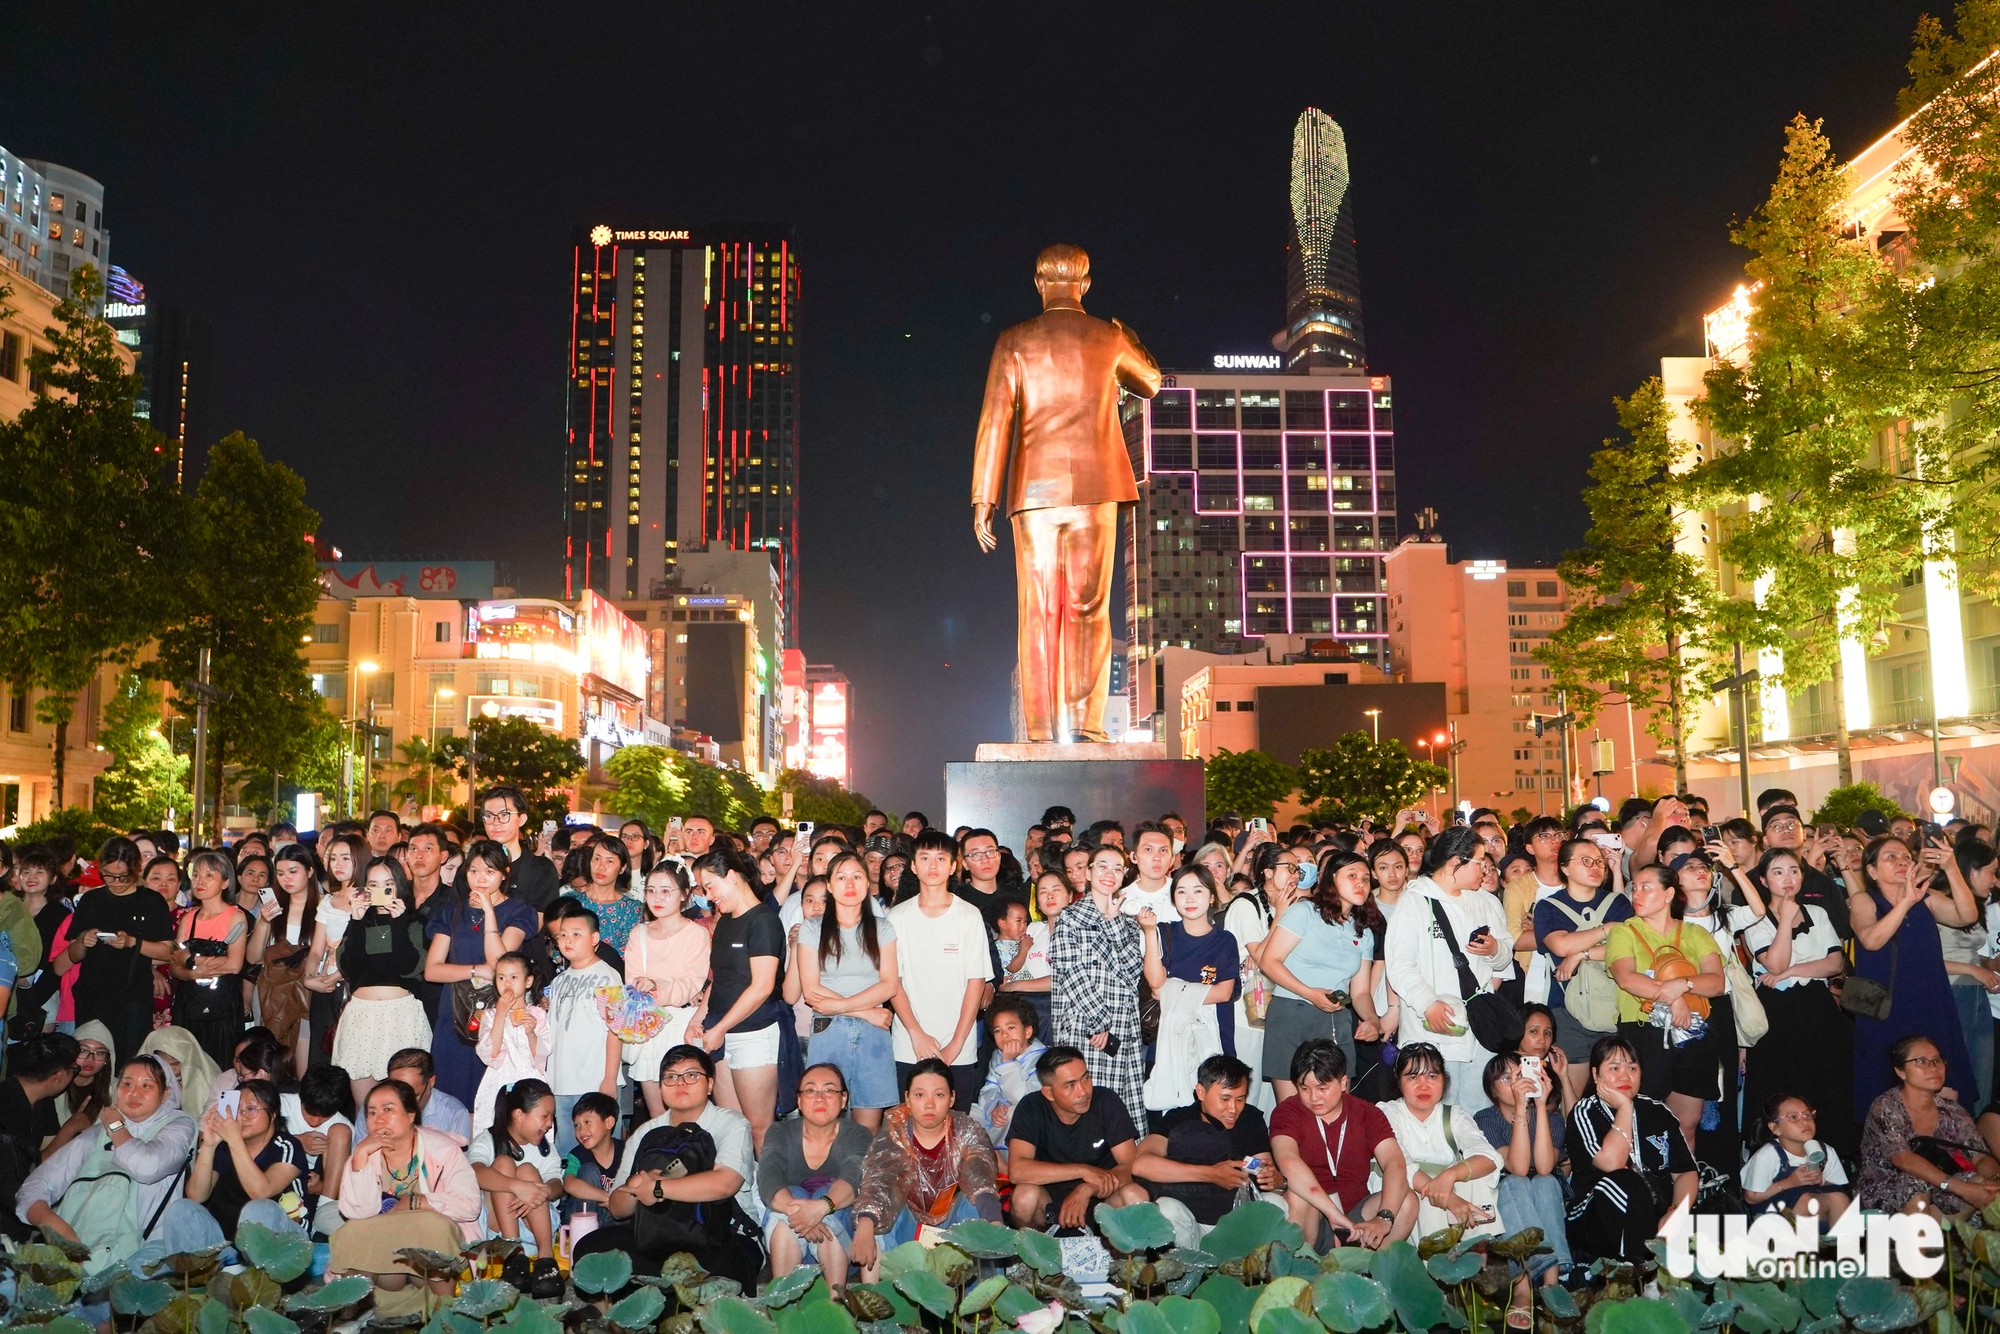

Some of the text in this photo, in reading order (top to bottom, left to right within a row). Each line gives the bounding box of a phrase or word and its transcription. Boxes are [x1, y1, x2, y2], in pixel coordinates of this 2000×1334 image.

[615, 231, 689, 241] TIMES SQUARE
[104, 303, 146, 318] Hilton
[1213, 355, 1280, 368] SUNWAH
